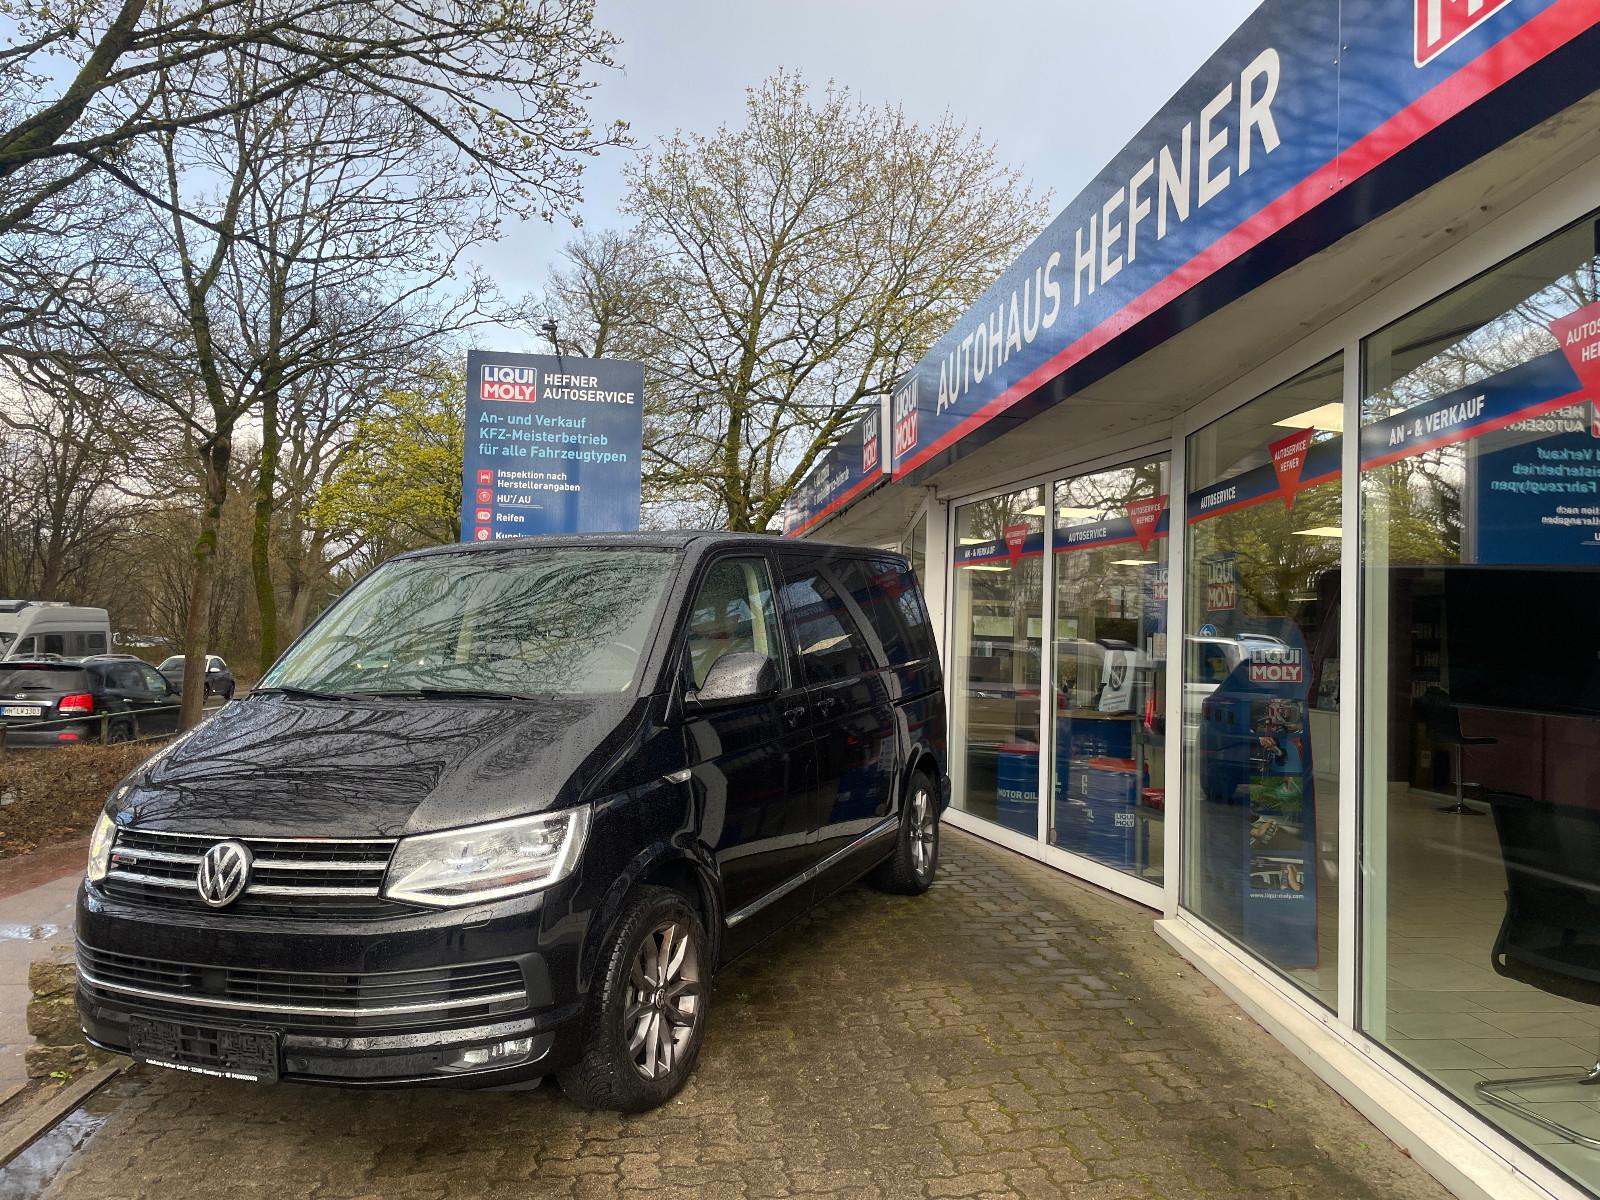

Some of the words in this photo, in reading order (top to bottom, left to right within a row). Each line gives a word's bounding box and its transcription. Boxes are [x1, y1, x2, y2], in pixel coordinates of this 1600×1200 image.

[936, 251, 1061, 417] AUTOHAUS
[1073, 47, 1281, 308] HEFNER
[484, 366, 534, 384] LIQUI
[544, 373, 598, 388] HEFNER
[483, 384, 534, 401] MOLY
[543, 388, 635, 405] AUTOSERVICE
[896, 380, 917, 423] LIQUI
[479, 411, 504, 424] An-
[507, 414, 532, 426] und
[535, 414, 587, 429] Verkauf
[1414, 419, 1423, 437] &
[1425, 394, 1486, 433] VERKAUF
[479, 427, 608, 446] KFZ-Meisterbetrieb
[895, 413, 917, 455] MOLY
[478, 443, 499, 456] für
[501, 445, 527, 457] alle
[530, 446, 627, 464] Fahrzeugtypen
[1274, 440, 1307, 460] AUTOSERVICE
[497, 469, 544, 480] Inspektion
[546, 472, 567, 481] nach
[497, 480, 581, 493] Herstellerangaben
[1200, 486, 1236, 510] AUTOSERVICE
[496, 513, 525, 523] Reifen
[1068, 527, 1107, 543] AUTOSERVICE
[1208, 586, 1234, 608] MOLY
[1252, 649, 1300, 664] LIQUI
[1252, 665, 1301, 680] MOLY
[1024, 791, 1038, 800] OIL
